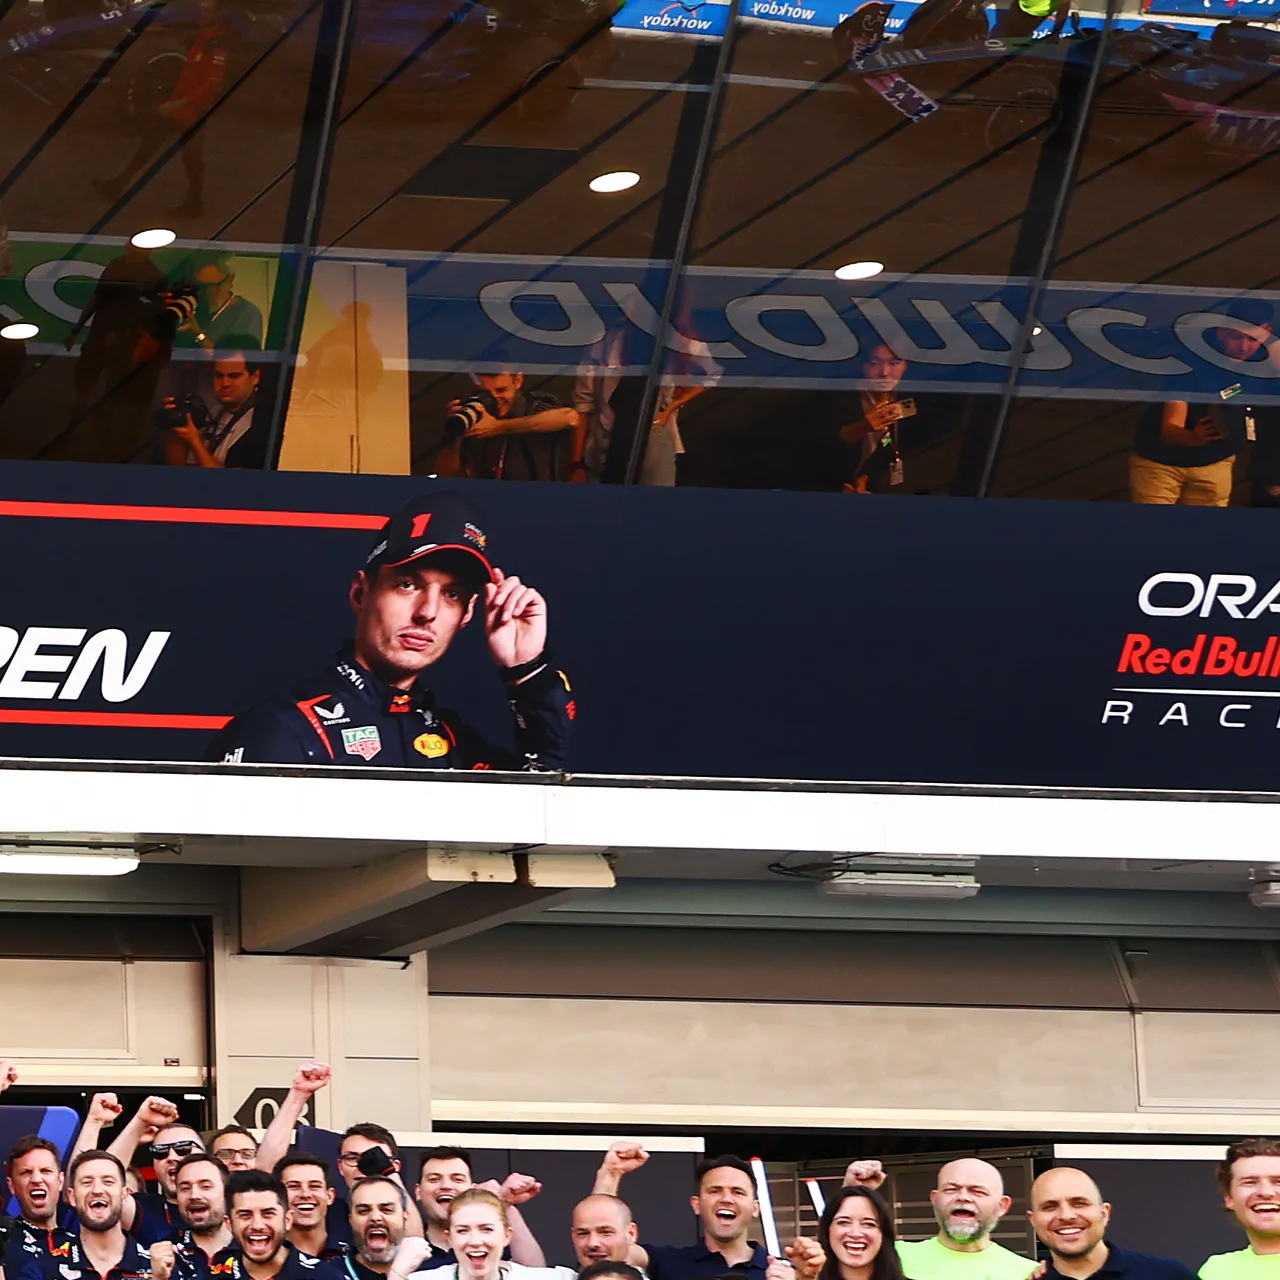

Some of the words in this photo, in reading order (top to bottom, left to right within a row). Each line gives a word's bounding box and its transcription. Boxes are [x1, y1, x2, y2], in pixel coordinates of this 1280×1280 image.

[410, 513, 432, 538] 1
[1117, 633, 1207, 675] Red
[1102, 700, 1280, 728] RAC
[345, 728, 377, 742] TAG
